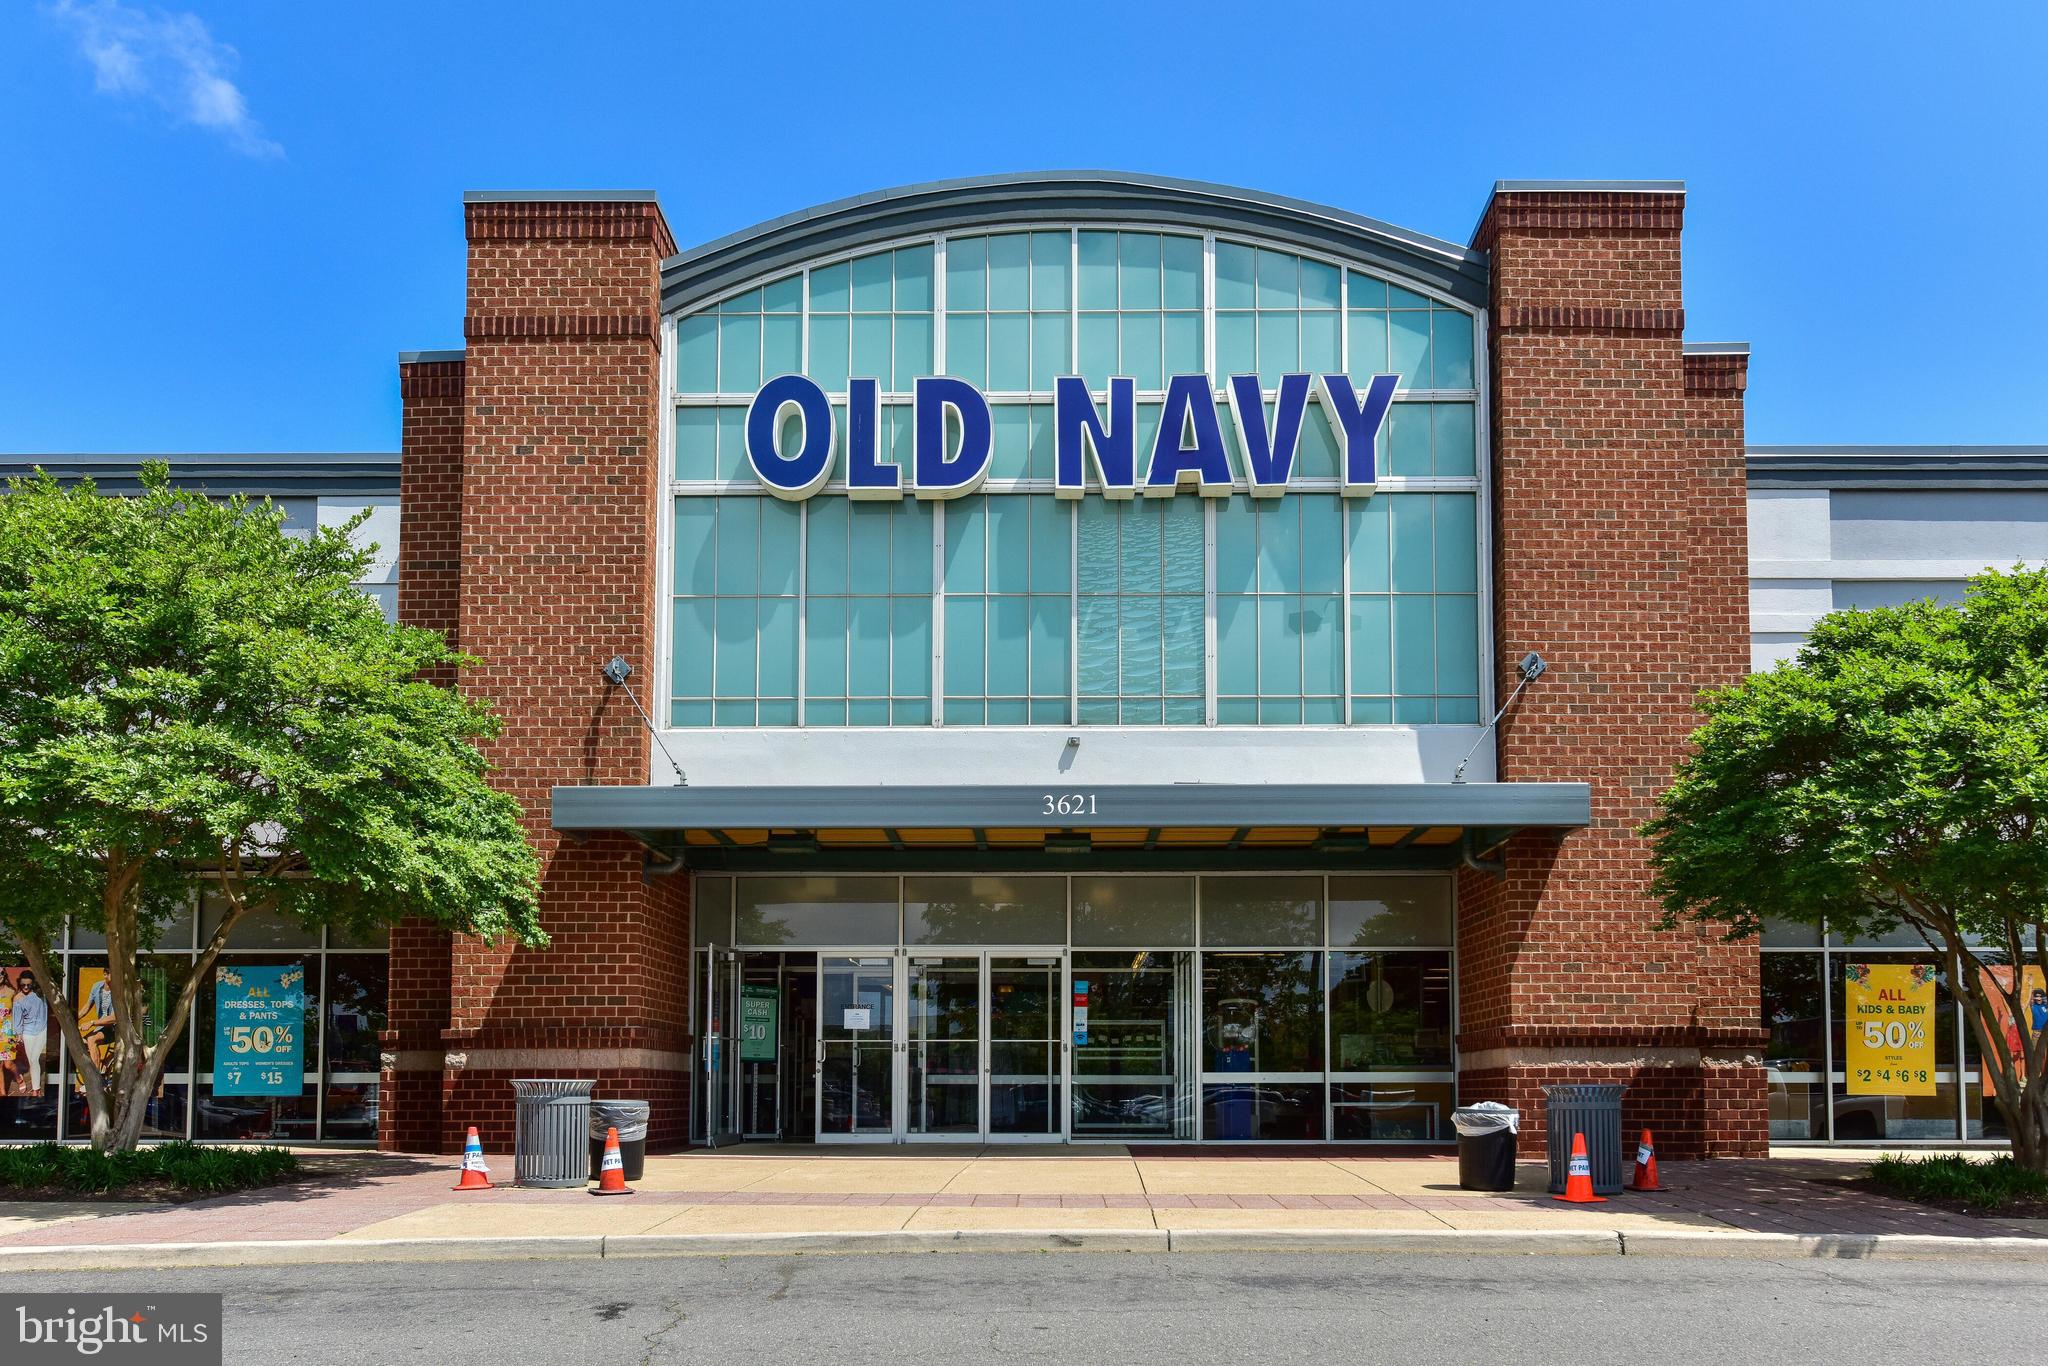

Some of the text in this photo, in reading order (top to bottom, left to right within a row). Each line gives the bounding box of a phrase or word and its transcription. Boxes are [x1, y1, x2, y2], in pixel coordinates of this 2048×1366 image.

[745, 372, 1403, 500] OLD NAVY
[1042, 794, 1098, 816] 3621
[248, 986, 271, 997] ALL
[1878, 989, 1906, 1001] ALL
[224, 1001, 268, 1009] DRESSES,
[745, 1000, 770, 1009] SUPER
[1857, 1005, 1926, 1014] KIDS & BABY
[239, 1012, 278, 1020] & PANTS
[747, 1008, 768, 1016] CASH
[743, 1023, 767, 1041] $10
[1863, 1020, 1926, 1049] 50%
[228, 1025, 293, 1054] 50%
[1908, 1041, 1925, 1049] OFF
[274, 1045, 293, 1053] OFF
[227, 1071, 284, 1085] $7 $15
[1857, 1069, 1927, 1083] $2 $4 $6 $8
